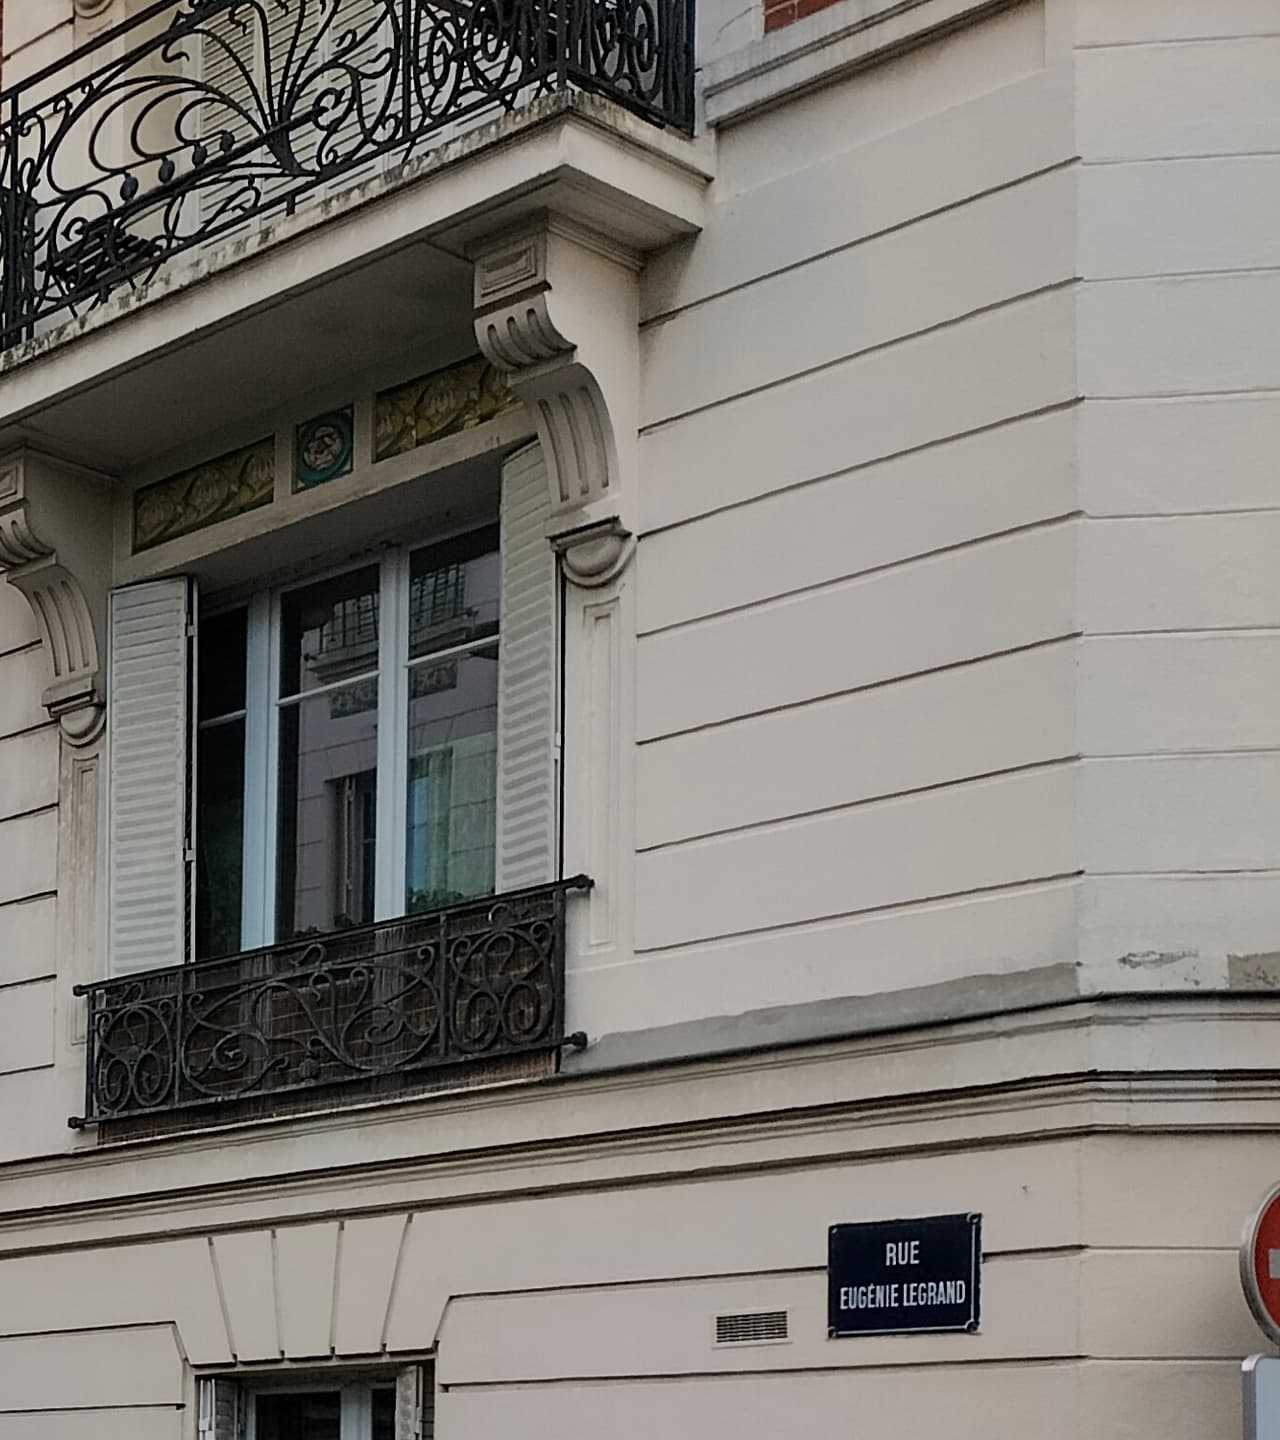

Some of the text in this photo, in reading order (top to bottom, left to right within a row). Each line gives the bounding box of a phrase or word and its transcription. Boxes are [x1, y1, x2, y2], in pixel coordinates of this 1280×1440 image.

[885, 1240, 920, 1266] RUE
[840, 1280, 966, 1310] EUGÉNIE LEGRAND
